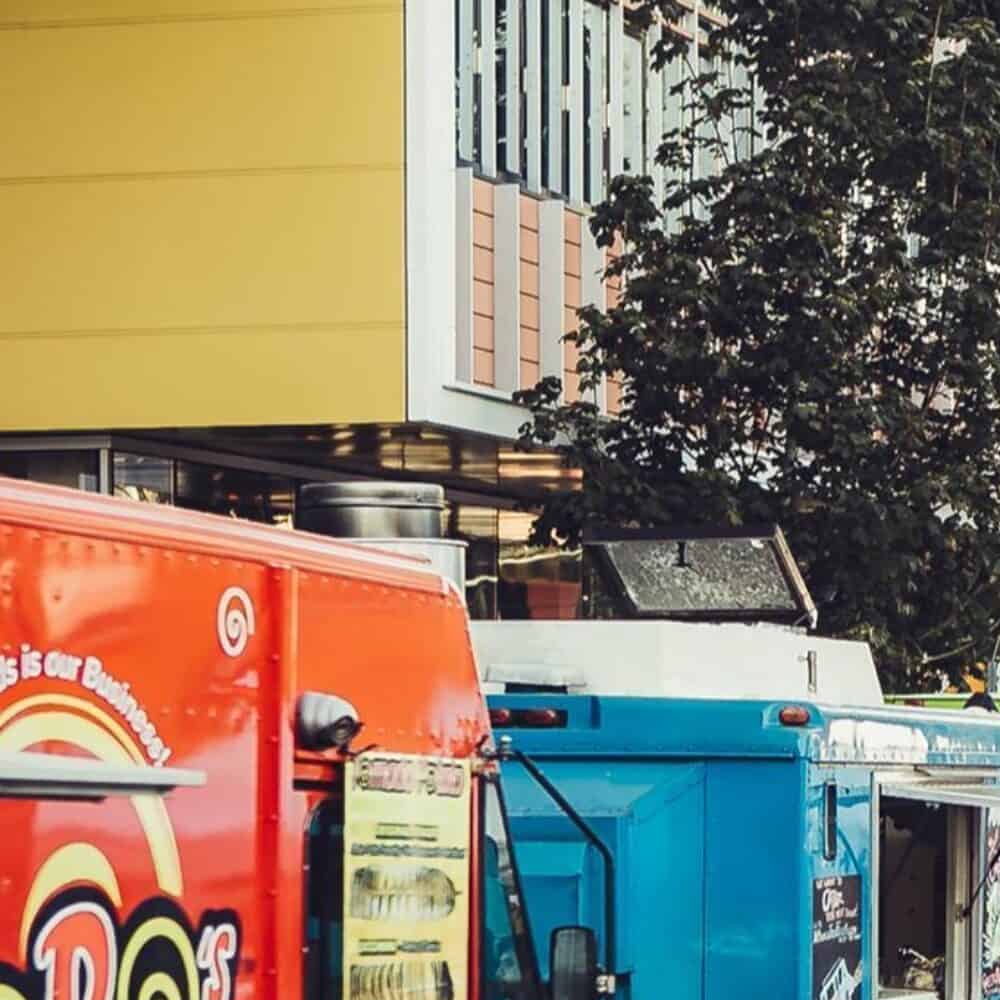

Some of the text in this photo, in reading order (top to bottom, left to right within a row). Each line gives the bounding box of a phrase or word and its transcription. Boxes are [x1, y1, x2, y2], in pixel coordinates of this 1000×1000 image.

[20, 643, 42, 679] is
[44, 650, 82, 681] our
[81, 656, 172, 767] Business!
